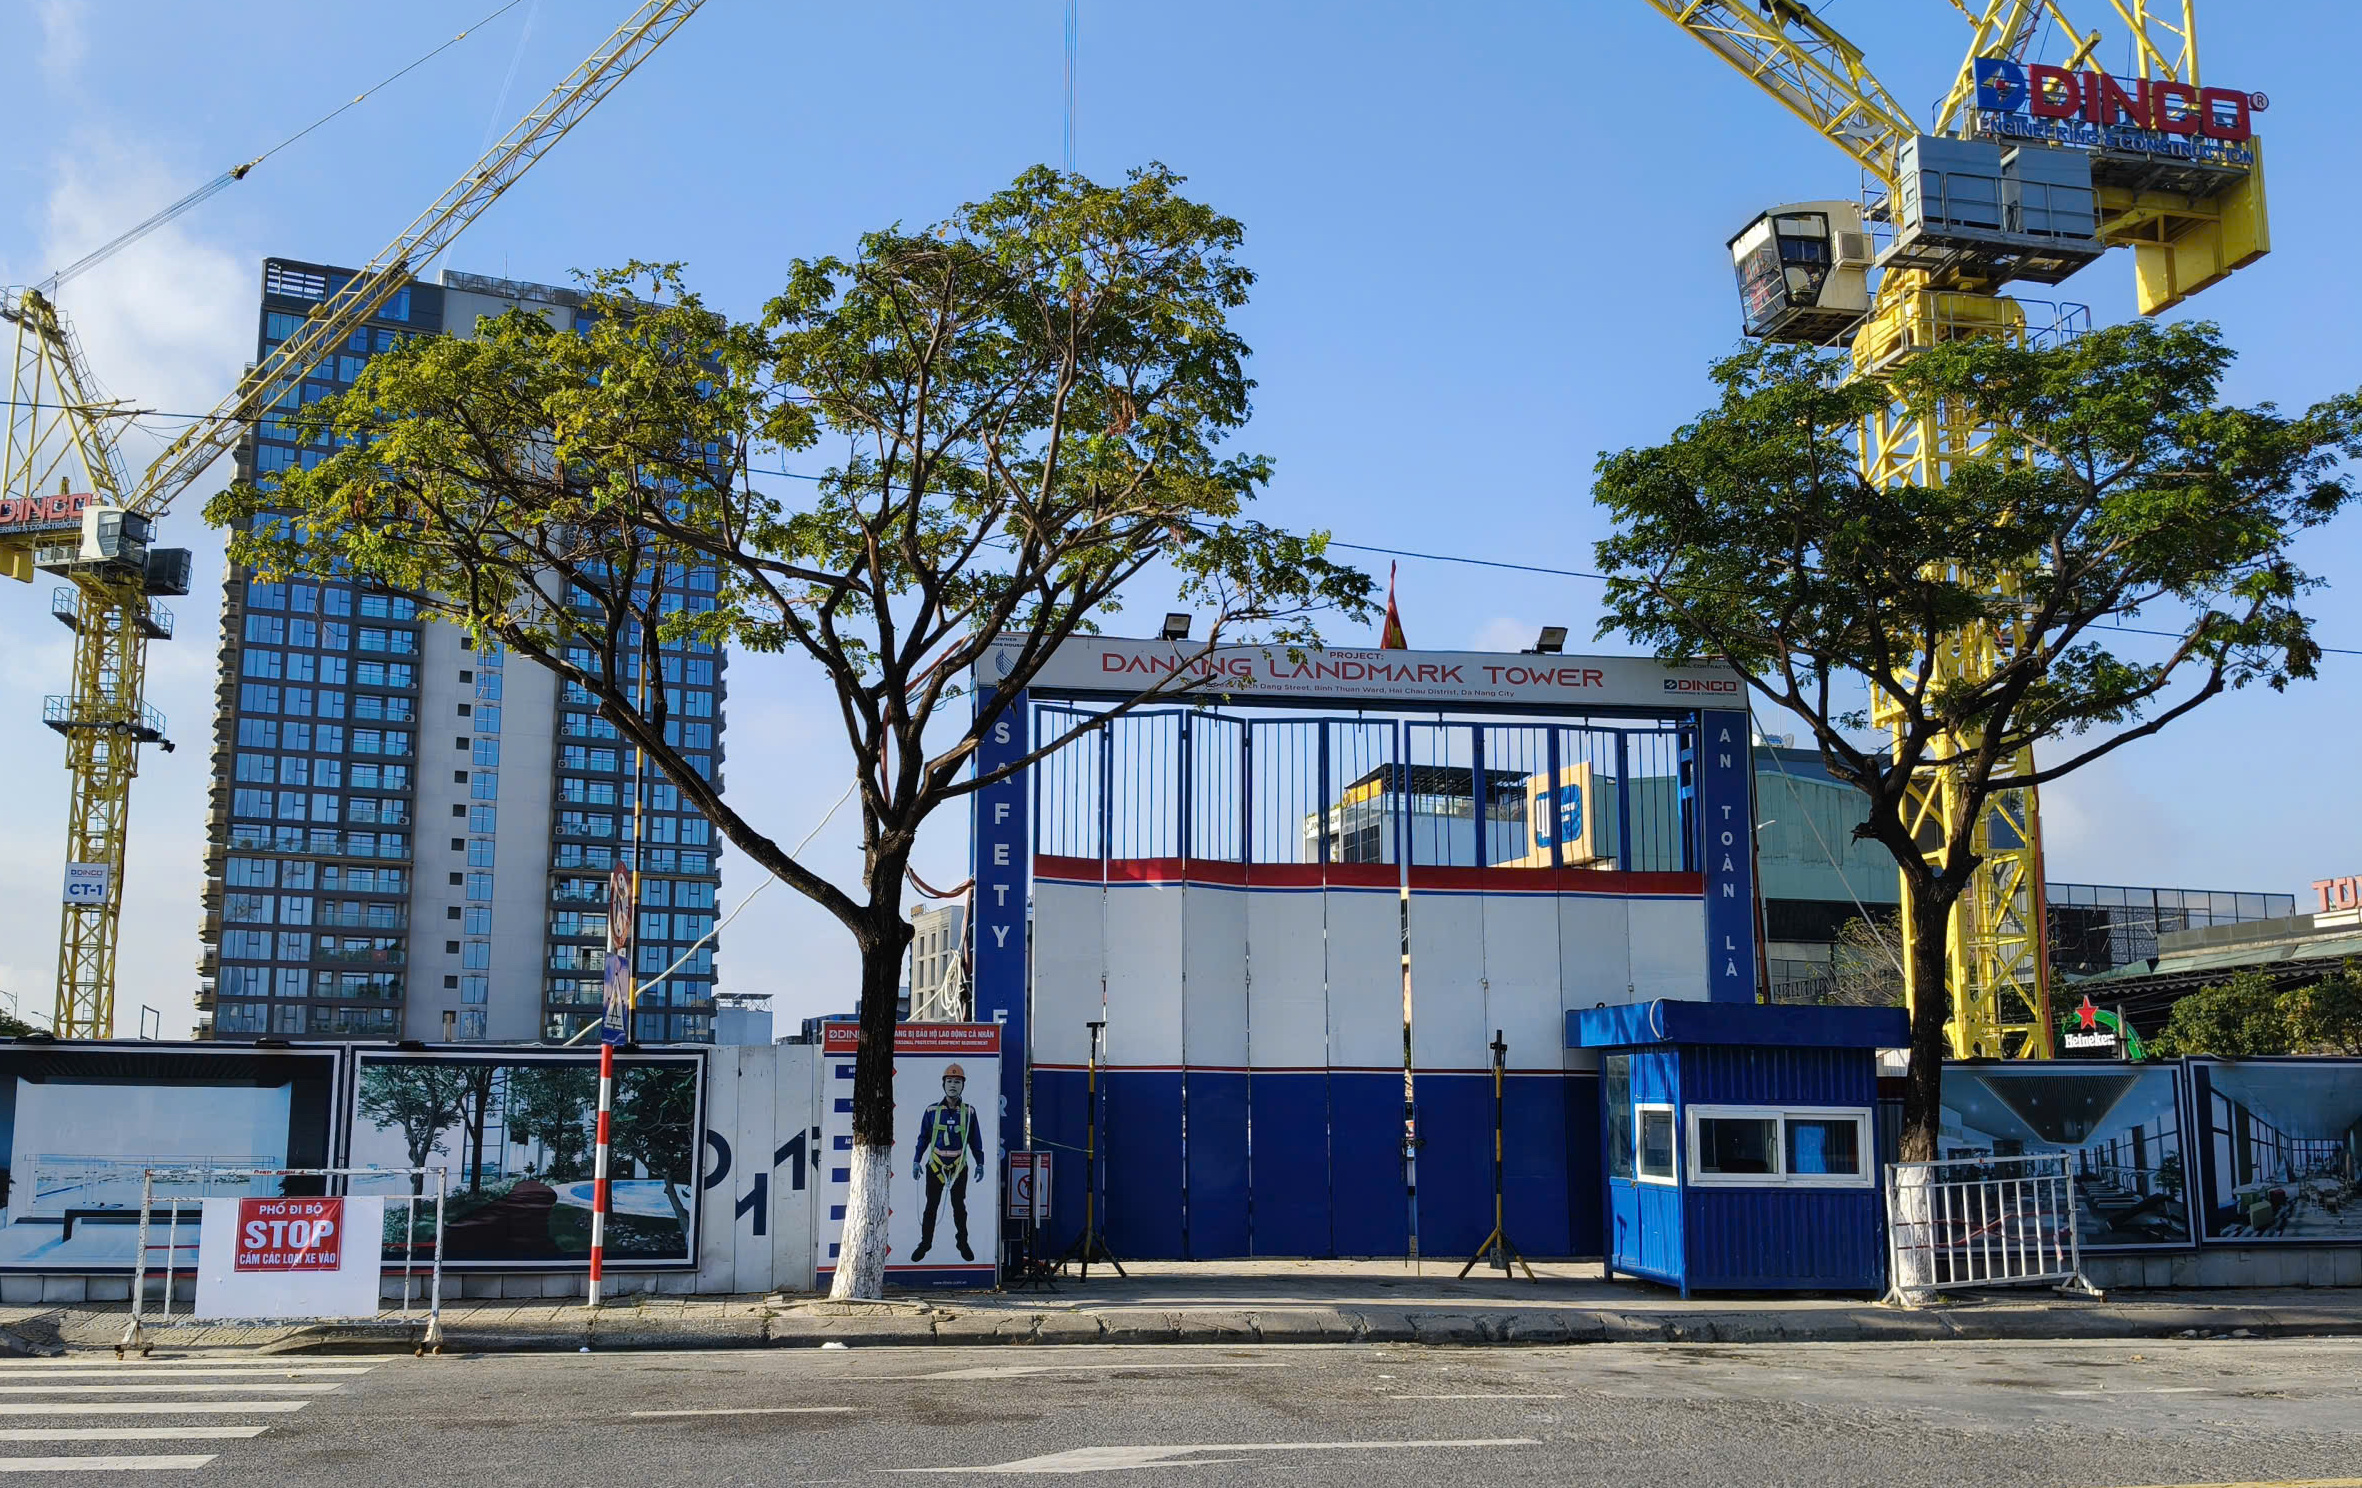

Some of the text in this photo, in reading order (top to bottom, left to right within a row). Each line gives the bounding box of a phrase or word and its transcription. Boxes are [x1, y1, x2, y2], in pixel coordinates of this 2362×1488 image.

[1329, 652, 1384, 660] PROJECT:
[1102, 653, 1604, 688] DANANG LANDMARK TOWER
[1404, 687, 1426, 695] Chau
[1678, 679, 1737, 692] DINCO
[991, 721, 1011, 948] SAFETY
[1719, 728, 1738, 977] AN TOÀN LÀ
[69, 883, 103, 896] CT-1
[259, 1200, 323, 1217] PHỐ ĐI BỘ
[244, 1220, 334, 1249] STOP
[239, 1250, 260, 1265] CẤM
[262, 1251, 281, 1264] CÁC
[305, 1253, 316, 1263] XE
[319, 1250, 336, 1264] VÀO
